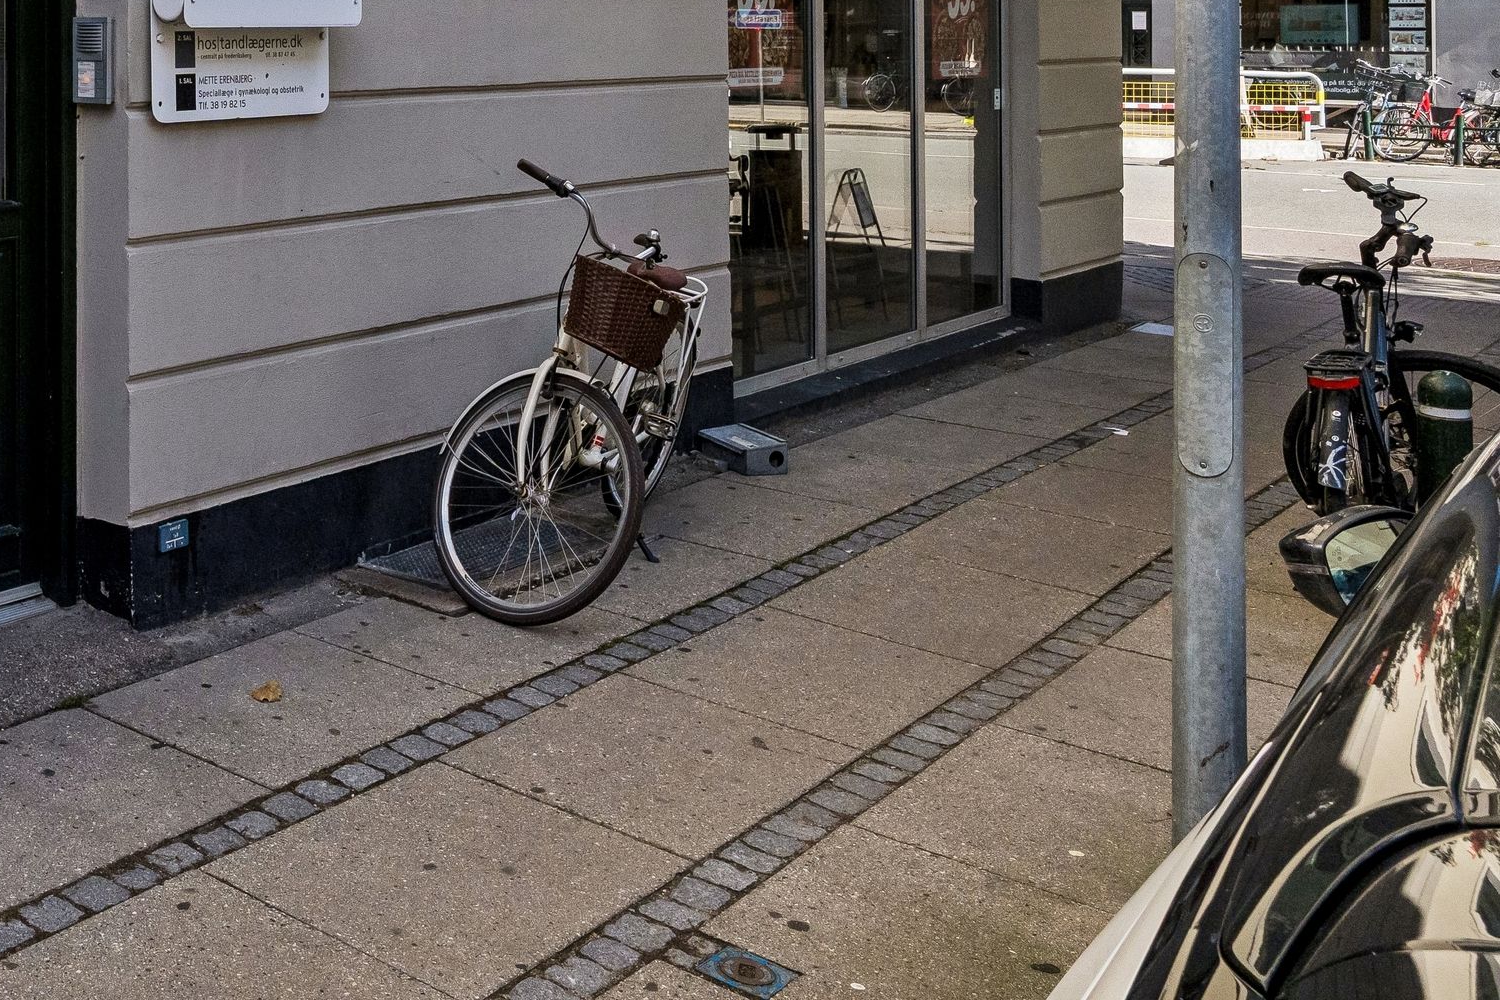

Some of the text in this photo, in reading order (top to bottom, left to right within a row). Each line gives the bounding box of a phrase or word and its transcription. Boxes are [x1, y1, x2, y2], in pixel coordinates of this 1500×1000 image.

[217, 52, 224, 60] på
[199, 74, 253, 85] METTE ERENBJERG
[198, 88, 234, 98] Speciallæge
[238, 87, 271, 98] gynækologi
[280, 85, 304, 94] obstetrik
[199, 99, 246, 110] Tlf. 38 19 82 15
